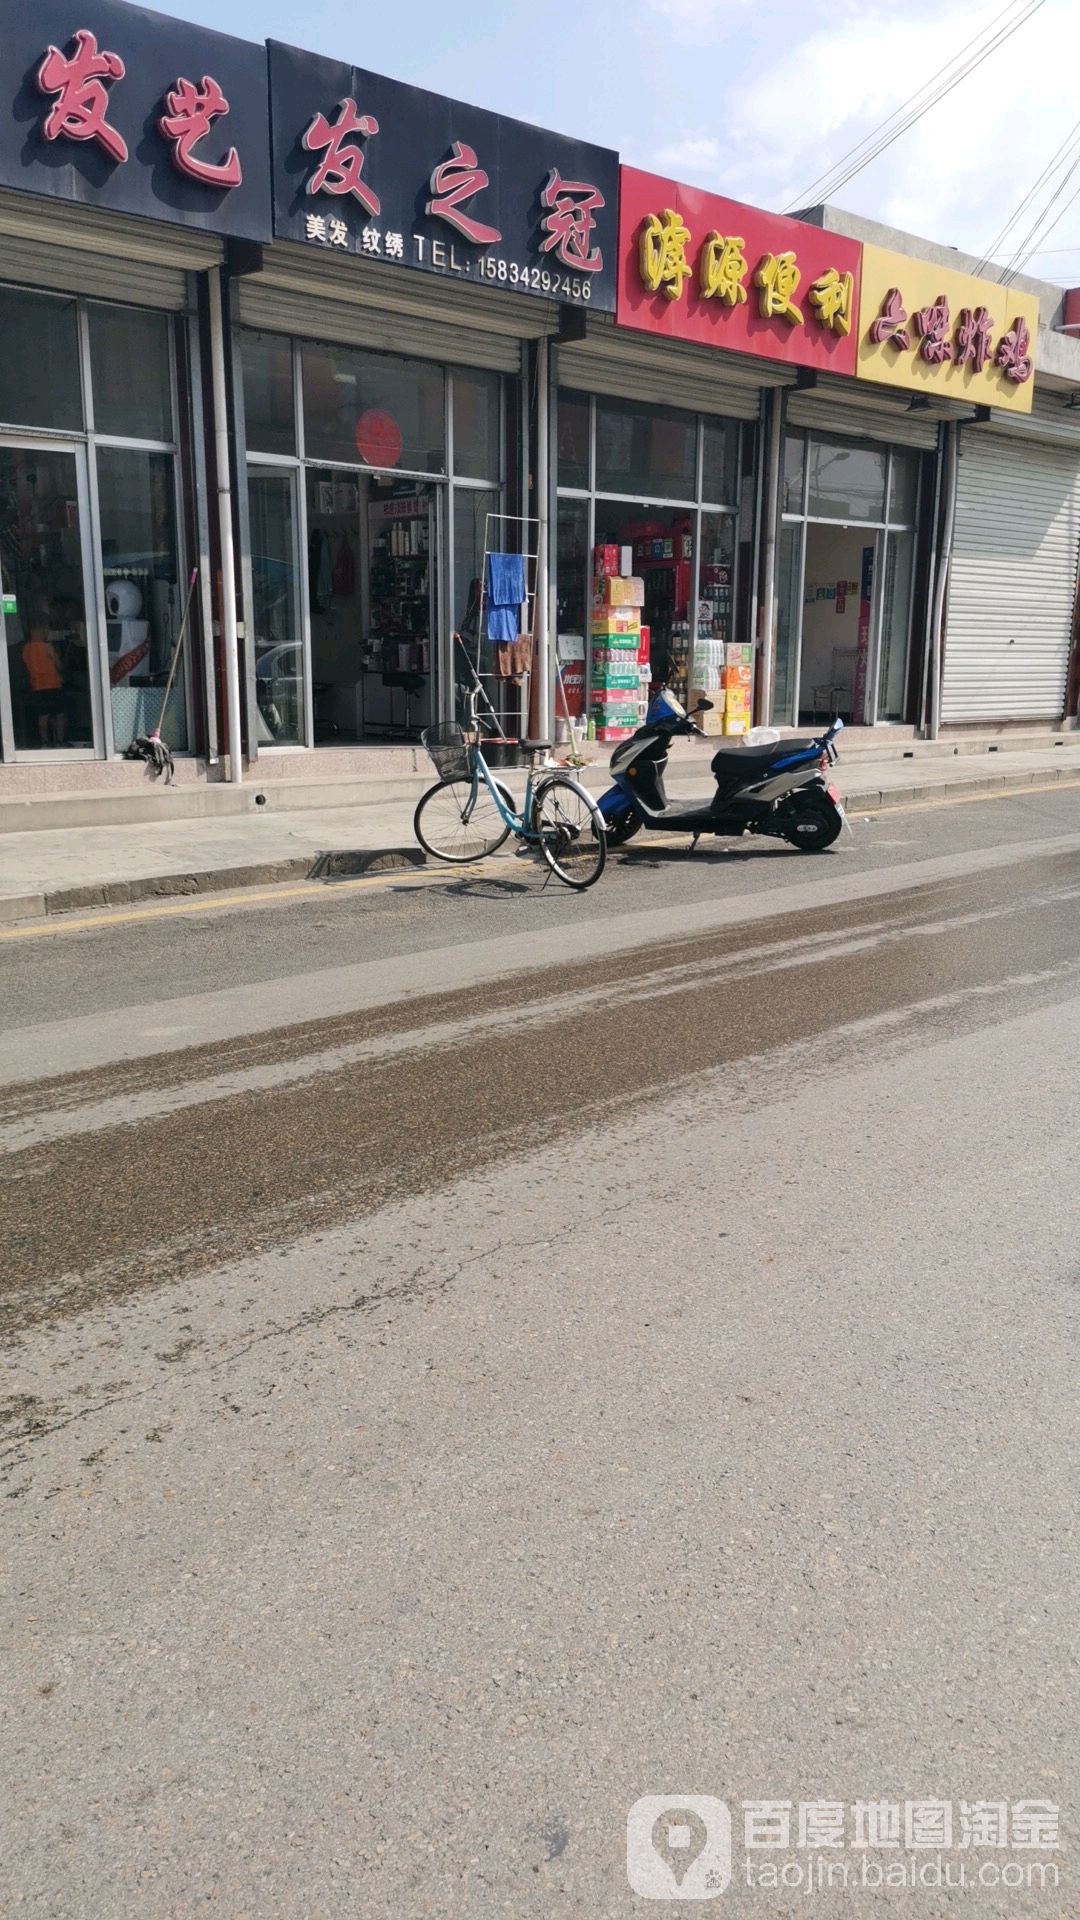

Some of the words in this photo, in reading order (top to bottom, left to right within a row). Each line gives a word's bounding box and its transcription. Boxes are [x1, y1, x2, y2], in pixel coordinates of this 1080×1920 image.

[39, 29, 243, 188] 发艺
[303, 98, 605, 273] 发之冠
[306, 213, 348, 248] 美发
[362, 226, 404, 258] 纹绣
